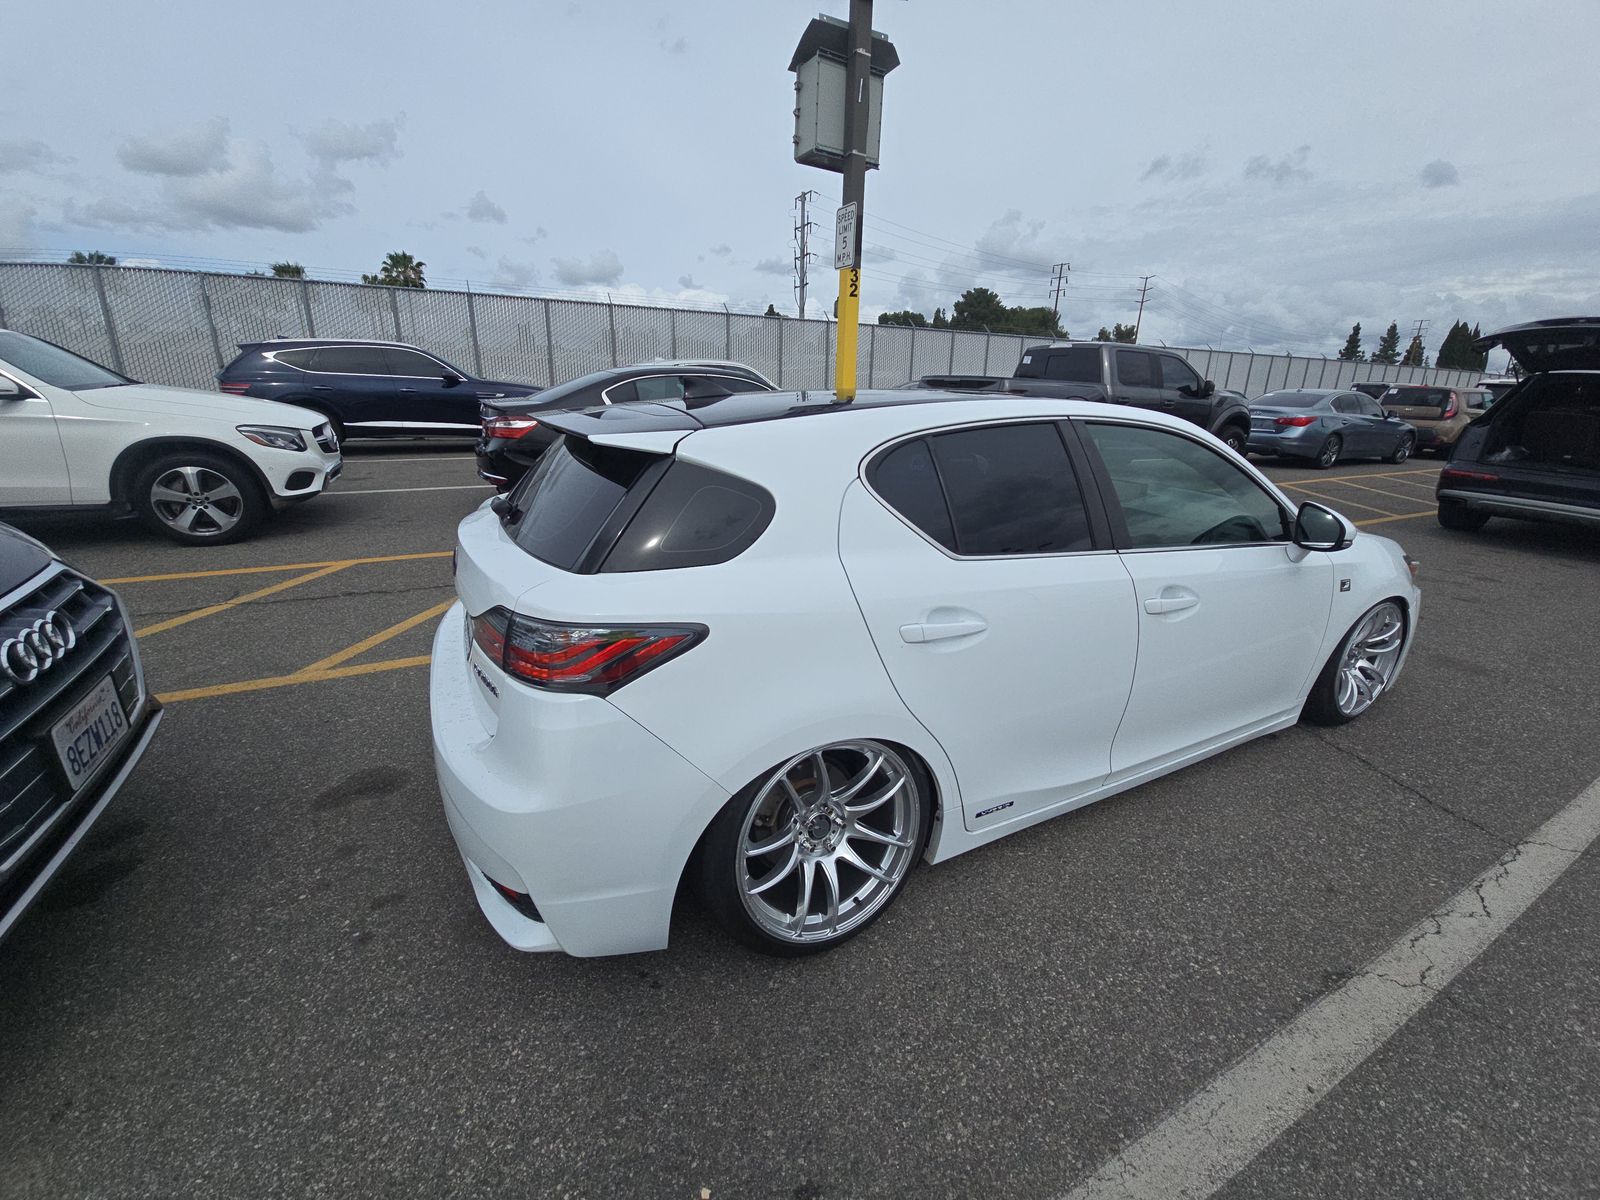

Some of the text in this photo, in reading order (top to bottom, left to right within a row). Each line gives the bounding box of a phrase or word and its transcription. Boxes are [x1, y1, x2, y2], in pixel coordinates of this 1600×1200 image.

[838, 210, 854, 224] SPEED
[838, 222, 852, 235] LIMIT
[842, 236, 848, 250] 5
[837, 253, 851, 263] MPH
[65, 691, 102, 734] Californ
[67, 701, 123, 776] 8EZW118
